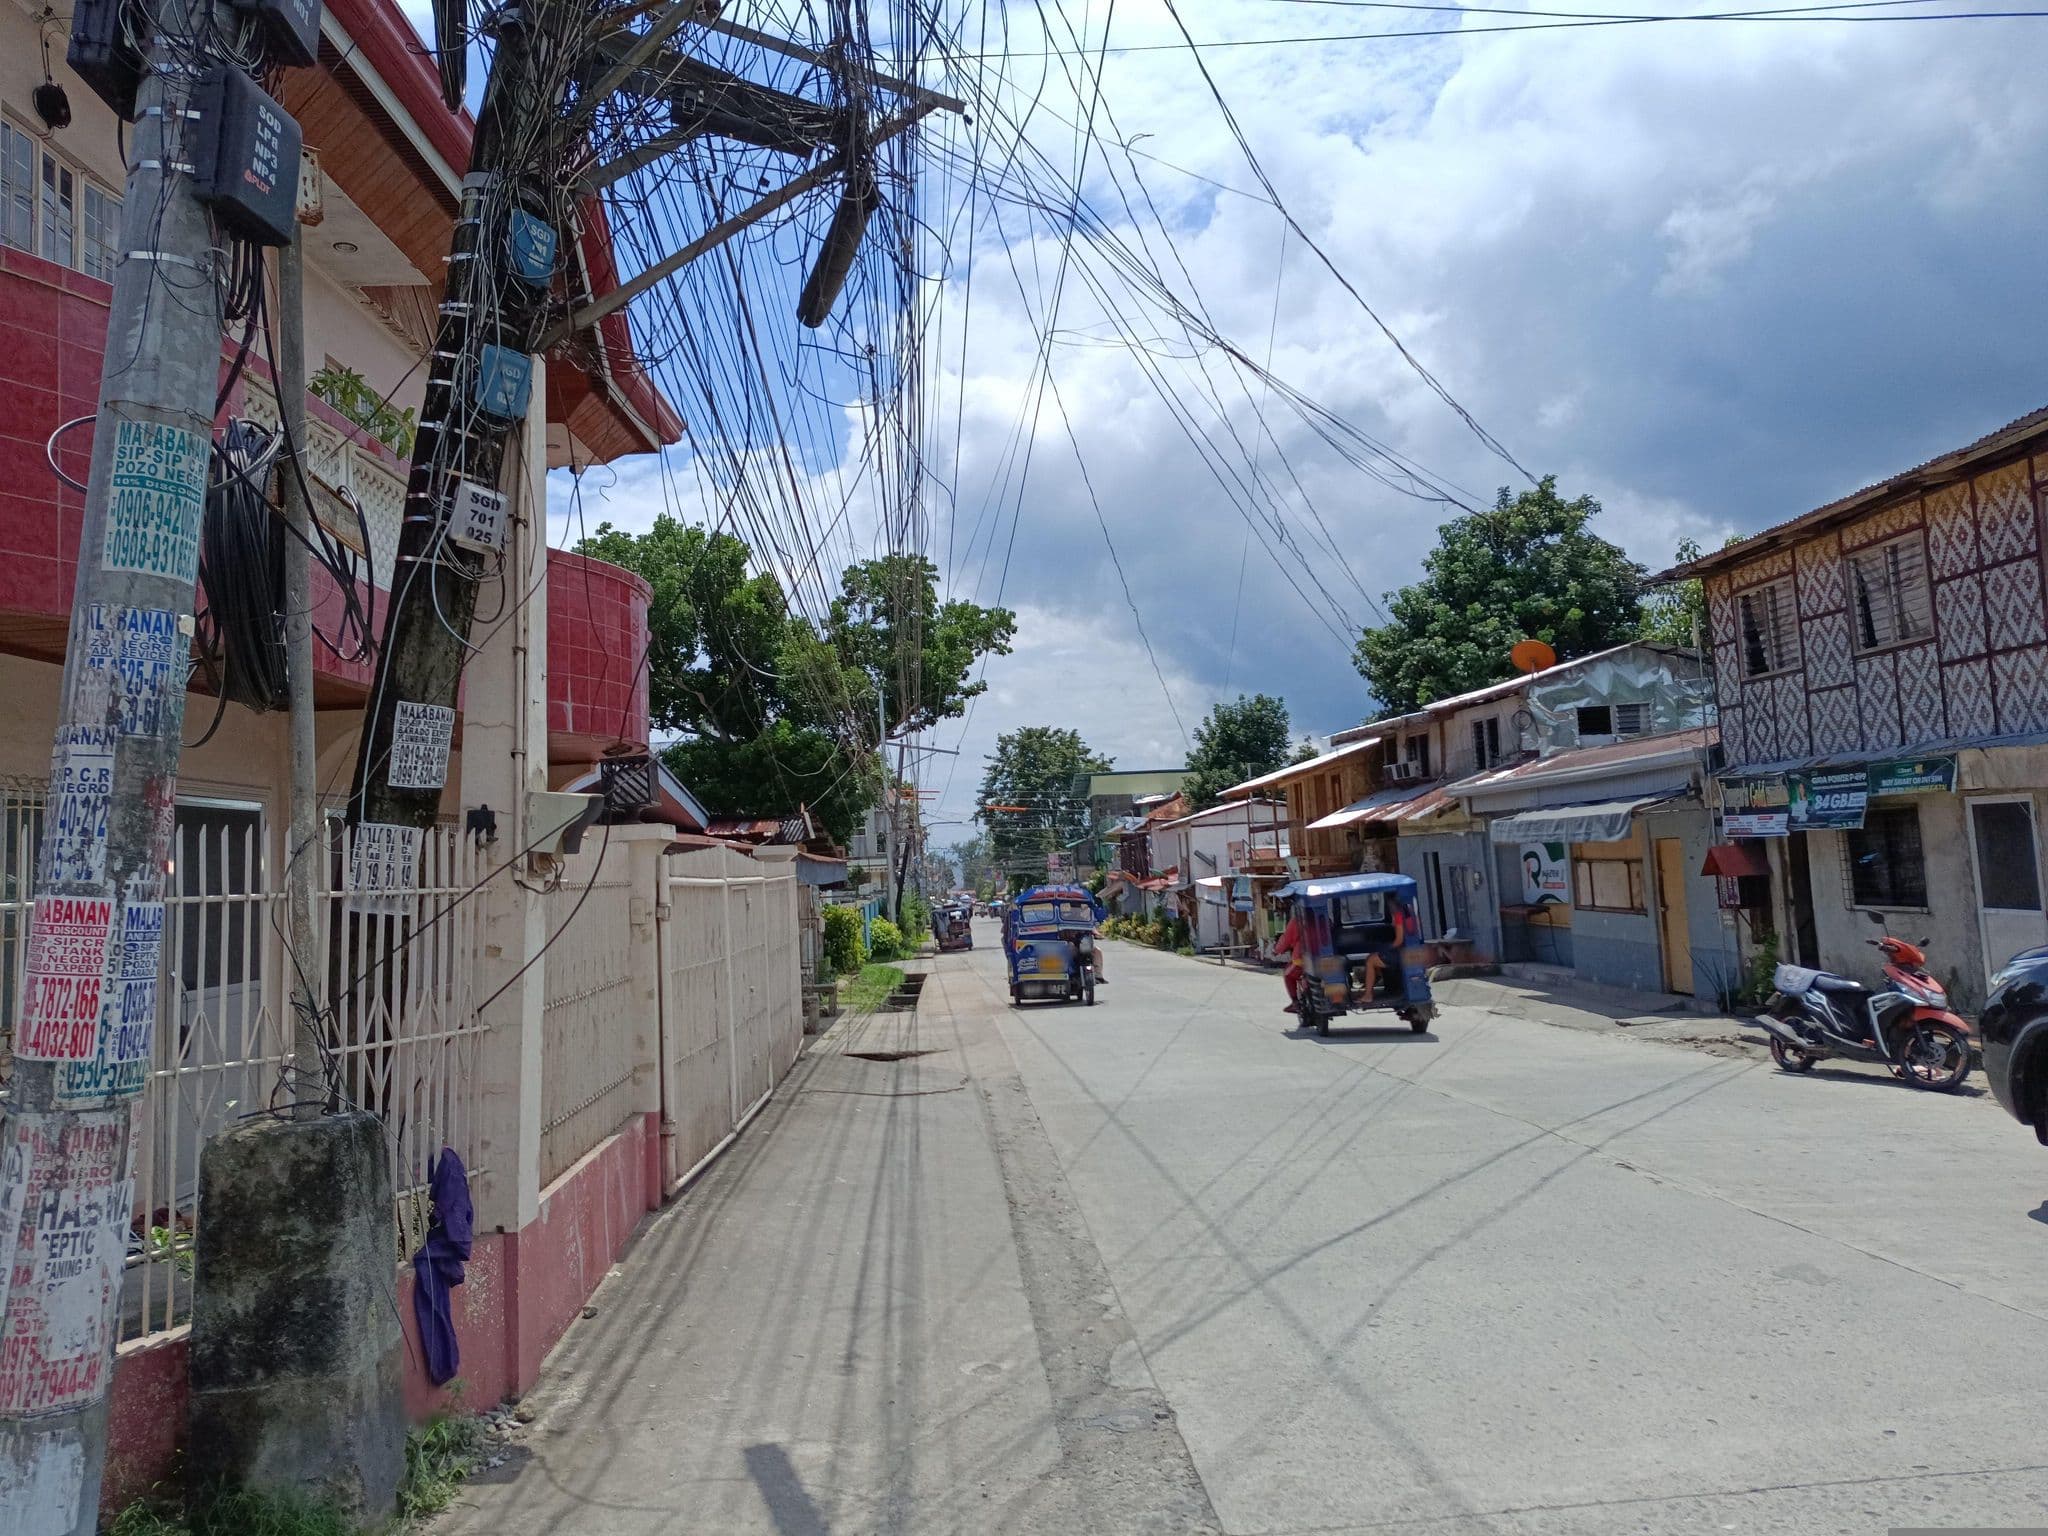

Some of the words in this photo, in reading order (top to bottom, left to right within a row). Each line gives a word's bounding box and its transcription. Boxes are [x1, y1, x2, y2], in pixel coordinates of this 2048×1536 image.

[115, 460, 158, 476] POZO
[115, 478, 140, 486] 10%
[471, 492, 500, 511] SGD
[116, 489, 199, 541] 0906-942
[470, 509, 494, 528] 701
[467, 527, 492, 544] 025
[400, 704, 453, 721] MALABAN
[54, 926, 107, 936] DISCOUNT
[54, 937, 77, 946] SIP
[83, 938, 104, 947] CR
[62, 946, 103, 956] TANK
[49, 955, 104, 964] NEGRO
[55, 964, 101, 974] EXPERT
[23, 975, 99, 1021] -7872-166
[18, 1019, 96, 1058] -4032-801
